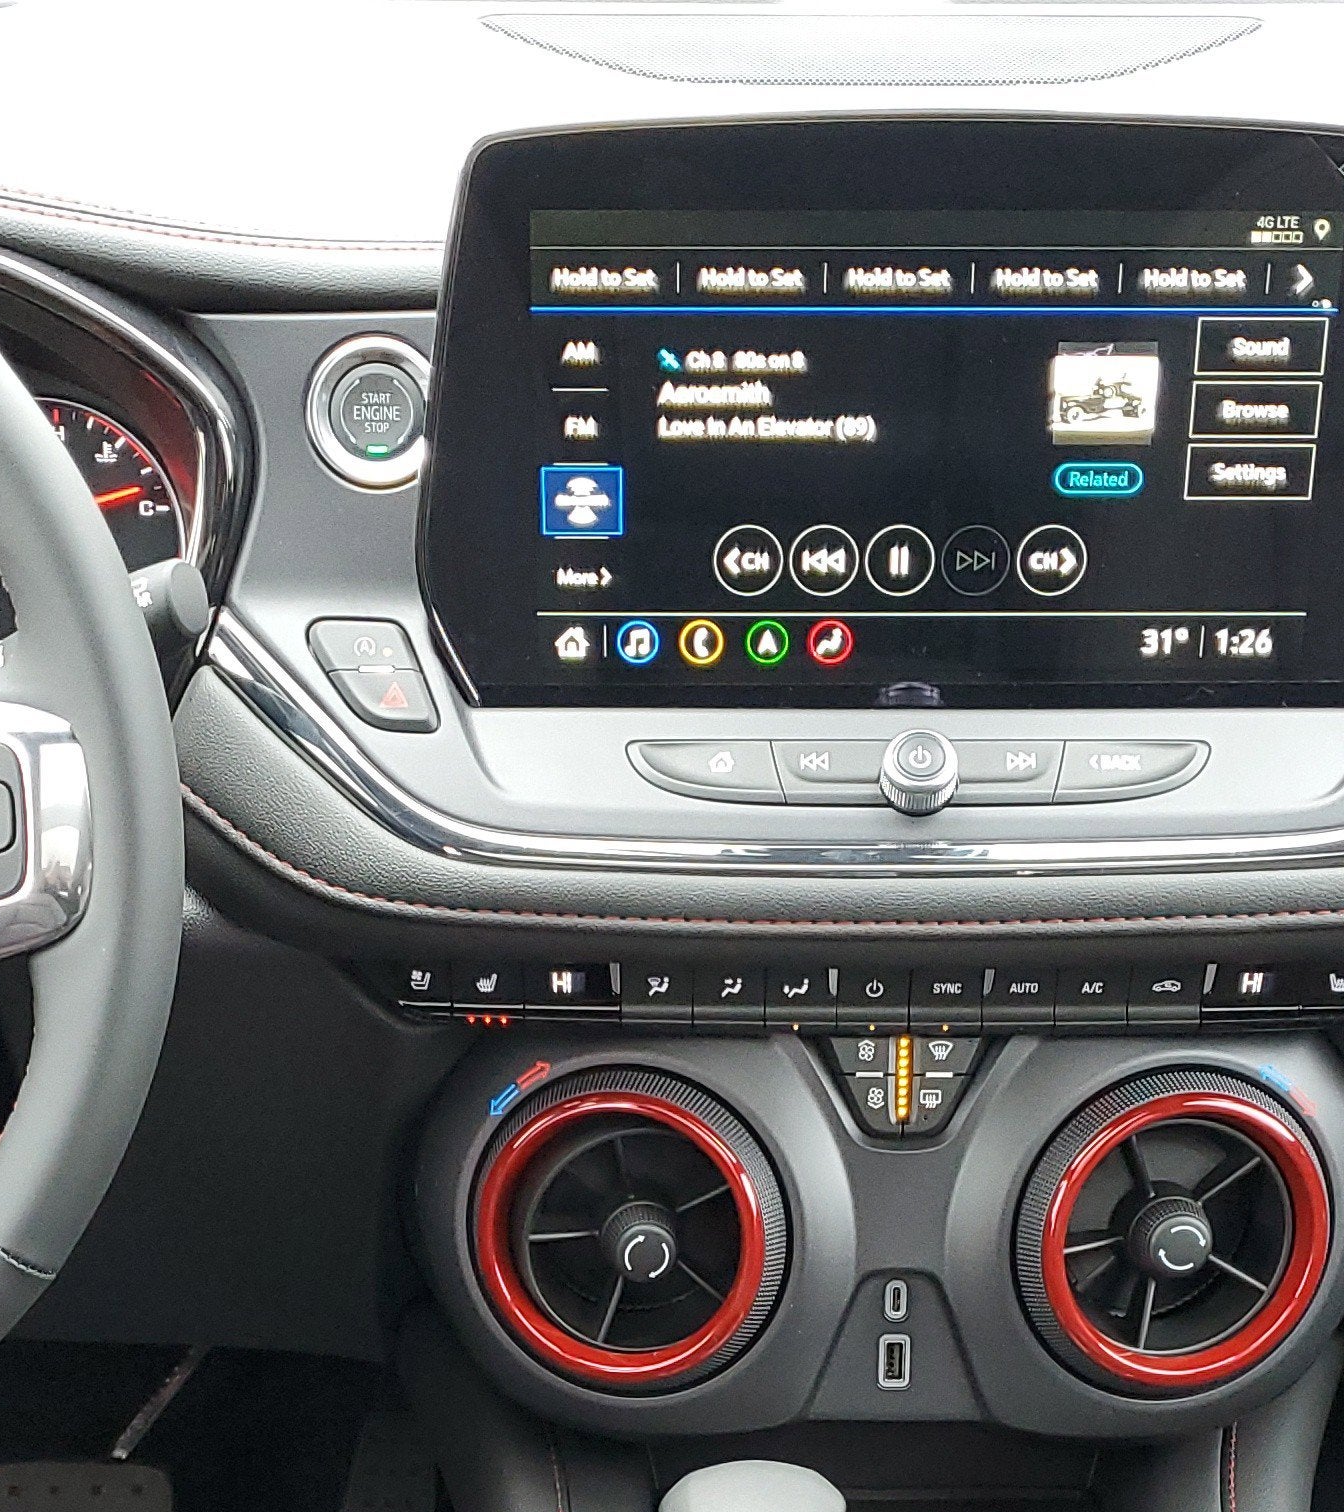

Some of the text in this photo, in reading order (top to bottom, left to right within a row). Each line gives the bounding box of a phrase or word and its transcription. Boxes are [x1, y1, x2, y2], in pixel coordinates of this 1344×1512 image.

[1257, 216, 1299, 229] 4G LTE
[552, 266, 658, 291] Hold to Set
[699, 266, 804, 291] Hold to Set
[847, 266, 952, 291] Hold to Set
[994, 266, 1099, 291] Hold to Set
[1142, 266, 1246, 291] Hold to Set
[562, 341, 598, 363] AM
[1228, 337, 1290, 361] Sound
[361, 392, 392, 404] START
[353, 405, 400, 421] ENGINE
[1219, 400, 1290, 422] Browse
[364, 422, 390, 433] STOP
[563, 415, 599, 438] FM
[1068, 470, 1129, 489] Related
[1209, 462, 1288, 489] Settings
[138, 500, 155, 517] C
[556, 567, 599, 588] More
[1214, 627, 1274, 656] 1:26
[932, 981, 962, 995] SYNC
[1009, 981, 1039, 995] AUTO
[1081, 981, 1104, 995] A/C
